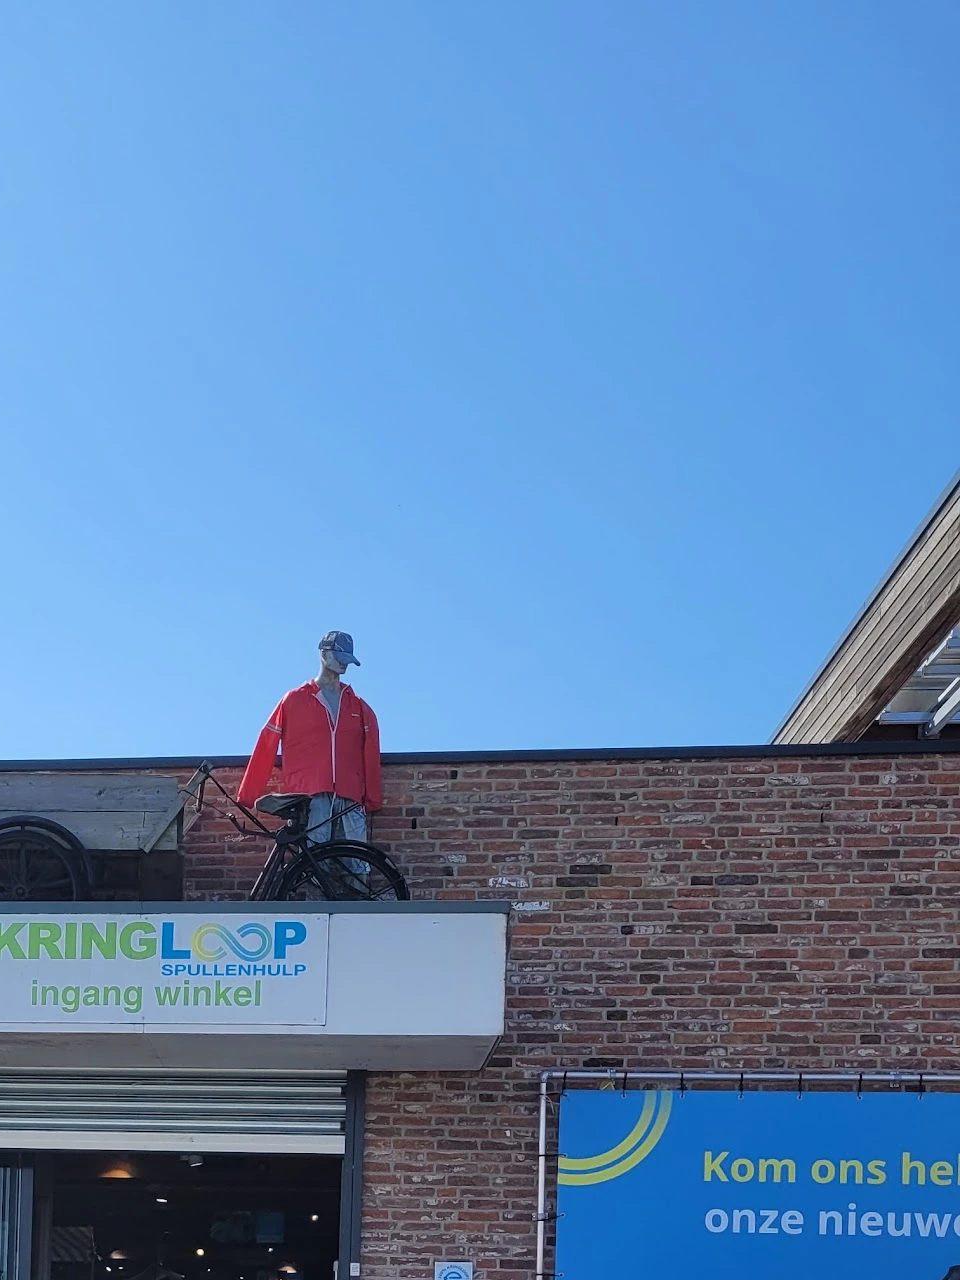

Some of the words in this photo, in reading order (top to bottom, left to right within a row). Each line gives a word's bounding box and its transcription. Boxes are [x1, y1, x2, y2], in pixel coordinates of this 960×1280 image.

[161, 964, 307, 976] SPULLENHULP
[31, 980, 143, 1013] ingang
[155, 980, 262, 1007] winkel
[703, 1151, 796, 1183] Kom
[811, 1159, 887, 1185] ons
[705, 1208, 804, 1235] onze
[818, 1203, 960, 1237] nieuw
